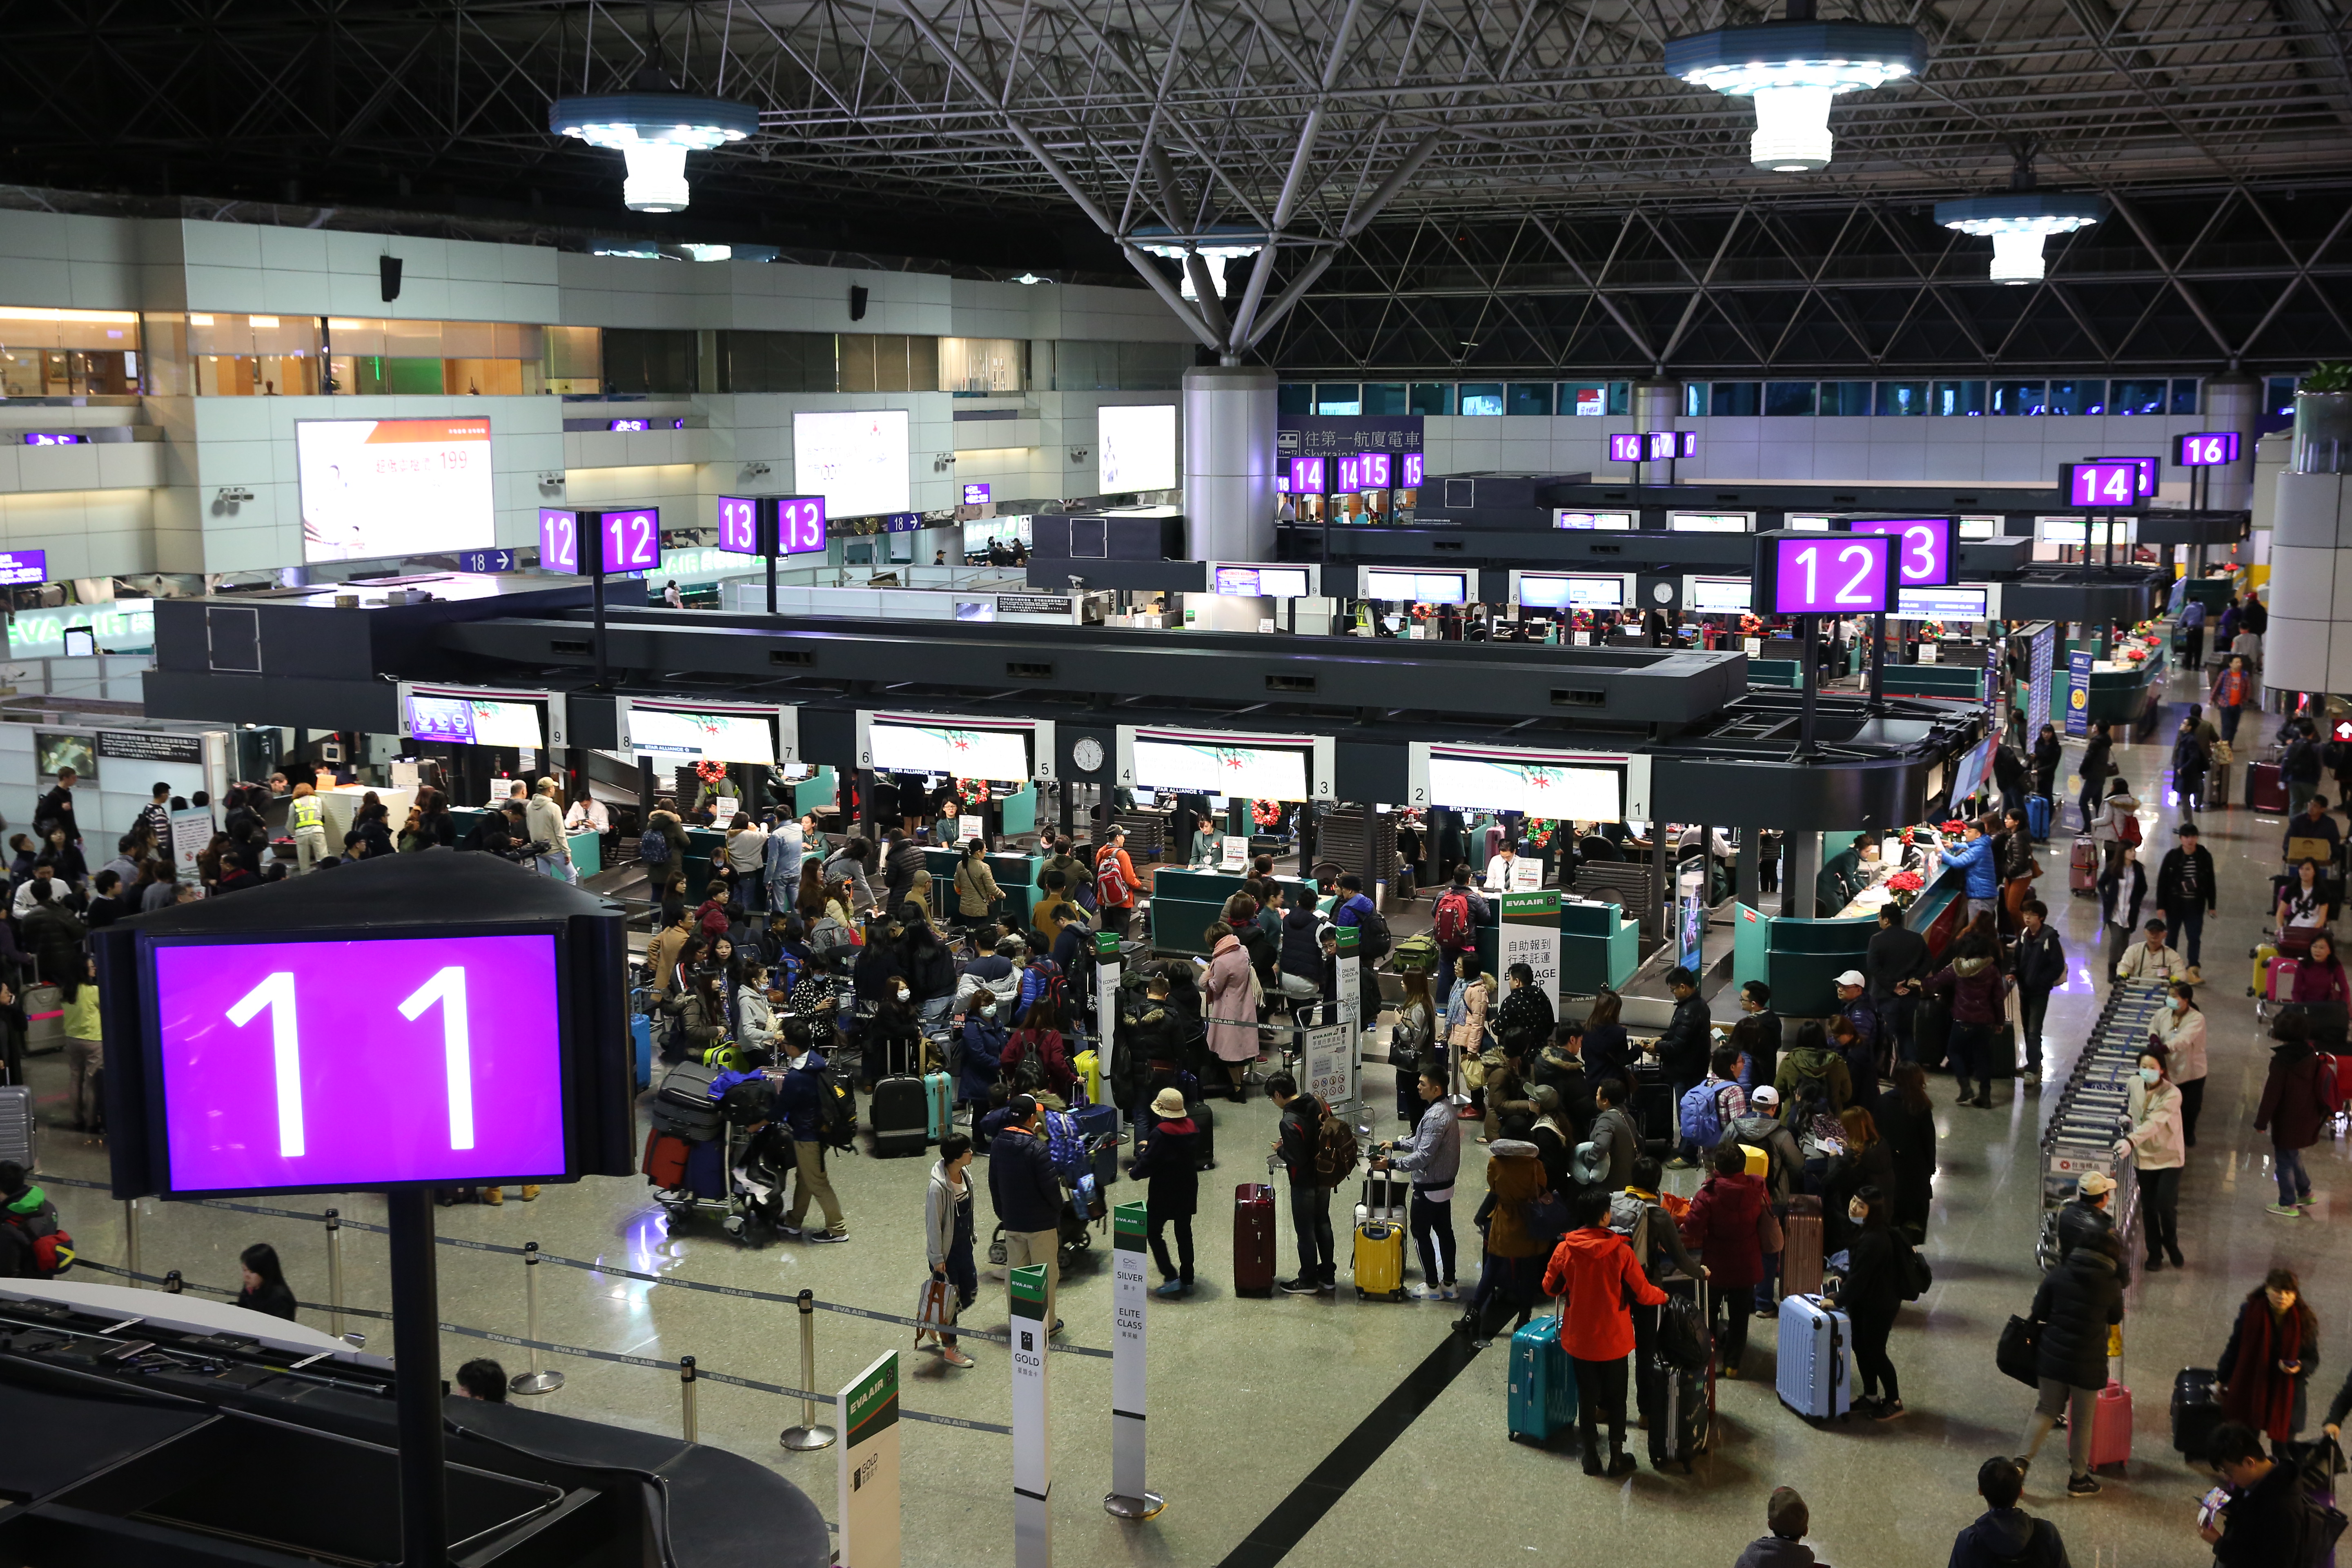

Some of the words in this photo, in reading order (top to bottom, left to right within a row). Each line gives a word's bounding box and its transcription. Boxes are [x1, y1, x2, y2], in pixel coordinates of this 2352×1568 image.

[1305, 430, 1420, 448] 往第一航廈電車
[1686, 434, 1695, 454] 17
[1616, 437, 1638, 459] 16
[1651, 437, 1660, 457] 16
[2189, 439, 2221, 463] 16
[440, 451, 467, 469] 199
[1296, 461, 1321, 490] 14
[1341, 461, 1358, 489] 14
[1363, 457, 1386, 484] 15
[1406, 457, 1421, 484] 15
[1278, 478, 1289, 491] 18
[2083, 469, 2127, 502] 14
[724, 504, 752, 548] 13
[786, 503, 819, 546] 13
[894, 517, 903, 530] 18
[546, 517, 573, 565] 12
[610, 516, 651, 564] 12
[471, 554, 485, 571] 18
[1796, 547, 1872, 603] 12
[2074, 693, 2083, 704] 30
[404, 721, 410, 731] 10
[555, 731, 561, 742] 9
[624, 736, 630, 747] 8
[786, 747, 792, 758] 7
[862, 752, 869, 763] 6
[1041, 763, 1049, 775] 5
[1123, 769, 1130, 781] 4
[1321, 781, 1327, 793] 3
[1415, 788, 1423, 800] 2
[1635, 802, 1640, 815] 1
[1508, 939, 1550, 952] 自助報到
[1508, 952, 1550, 966] 行李託運
[1505, 969, 1556, 981] BAGE
[225, 966, 474, 1156] 11
[1117, 1271, 1143, 1282] SILVER
[1119, 1308, 1140, 1318] ELITE
[1117, 1319, 1142, 1330] CLASS
[1015, 1353, 1039, 1366] GOLD
[862, 1453, 878, 1474] GOLD
